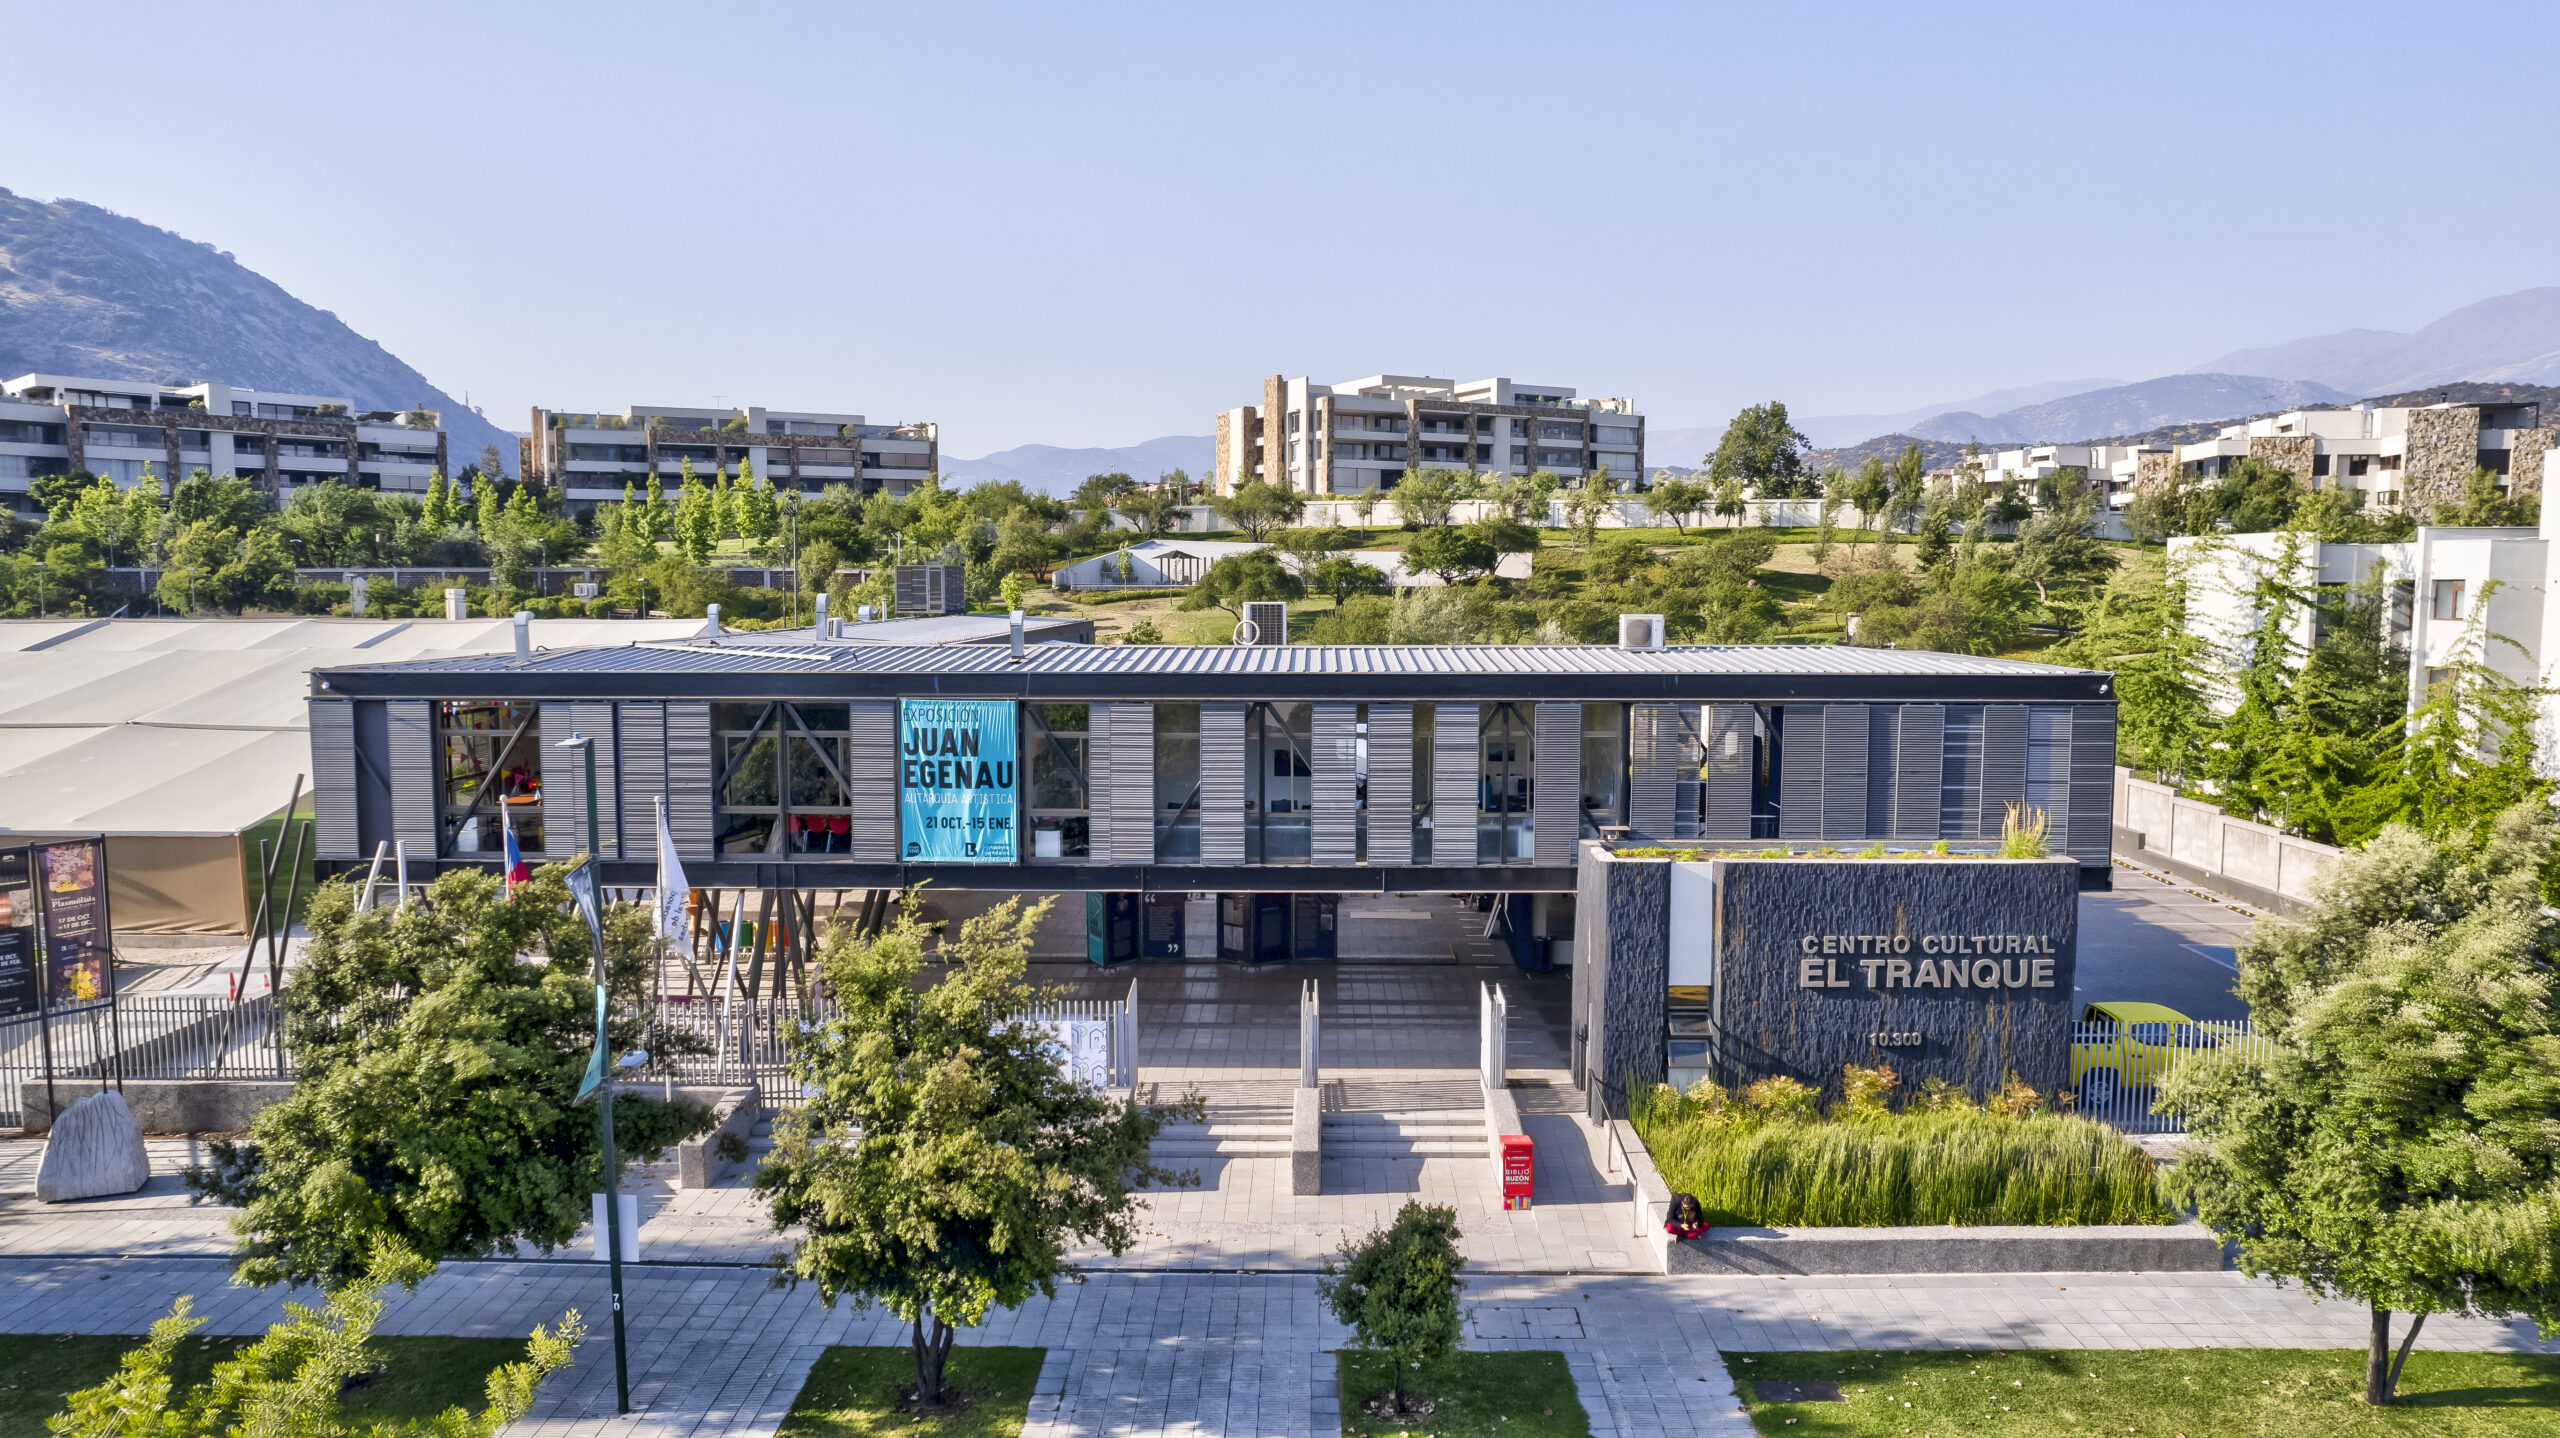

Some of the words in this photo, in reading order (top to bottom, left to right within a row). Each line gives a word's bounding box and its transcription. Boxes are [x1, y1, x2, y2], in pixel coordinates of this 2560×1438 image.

[904, 728, 979, 757] JUAN
[904, 760, 1013, 789] EGENAU
[926, 816, 938, 829] 21
[988, 817, 1014, 829] ENE.
[67, 915, 77, 923] DE
[1802, 935, 1911, 954] CENTRO
[1922, 935, 2056, 954] CULTURAL
[1800, 958, 1850, 988] EL
[1860, 958, 2056, 989] TRANQUE
[1869, 1032, 1922, 1047] 10.300
[613, 1293, 620, 1311] 70
